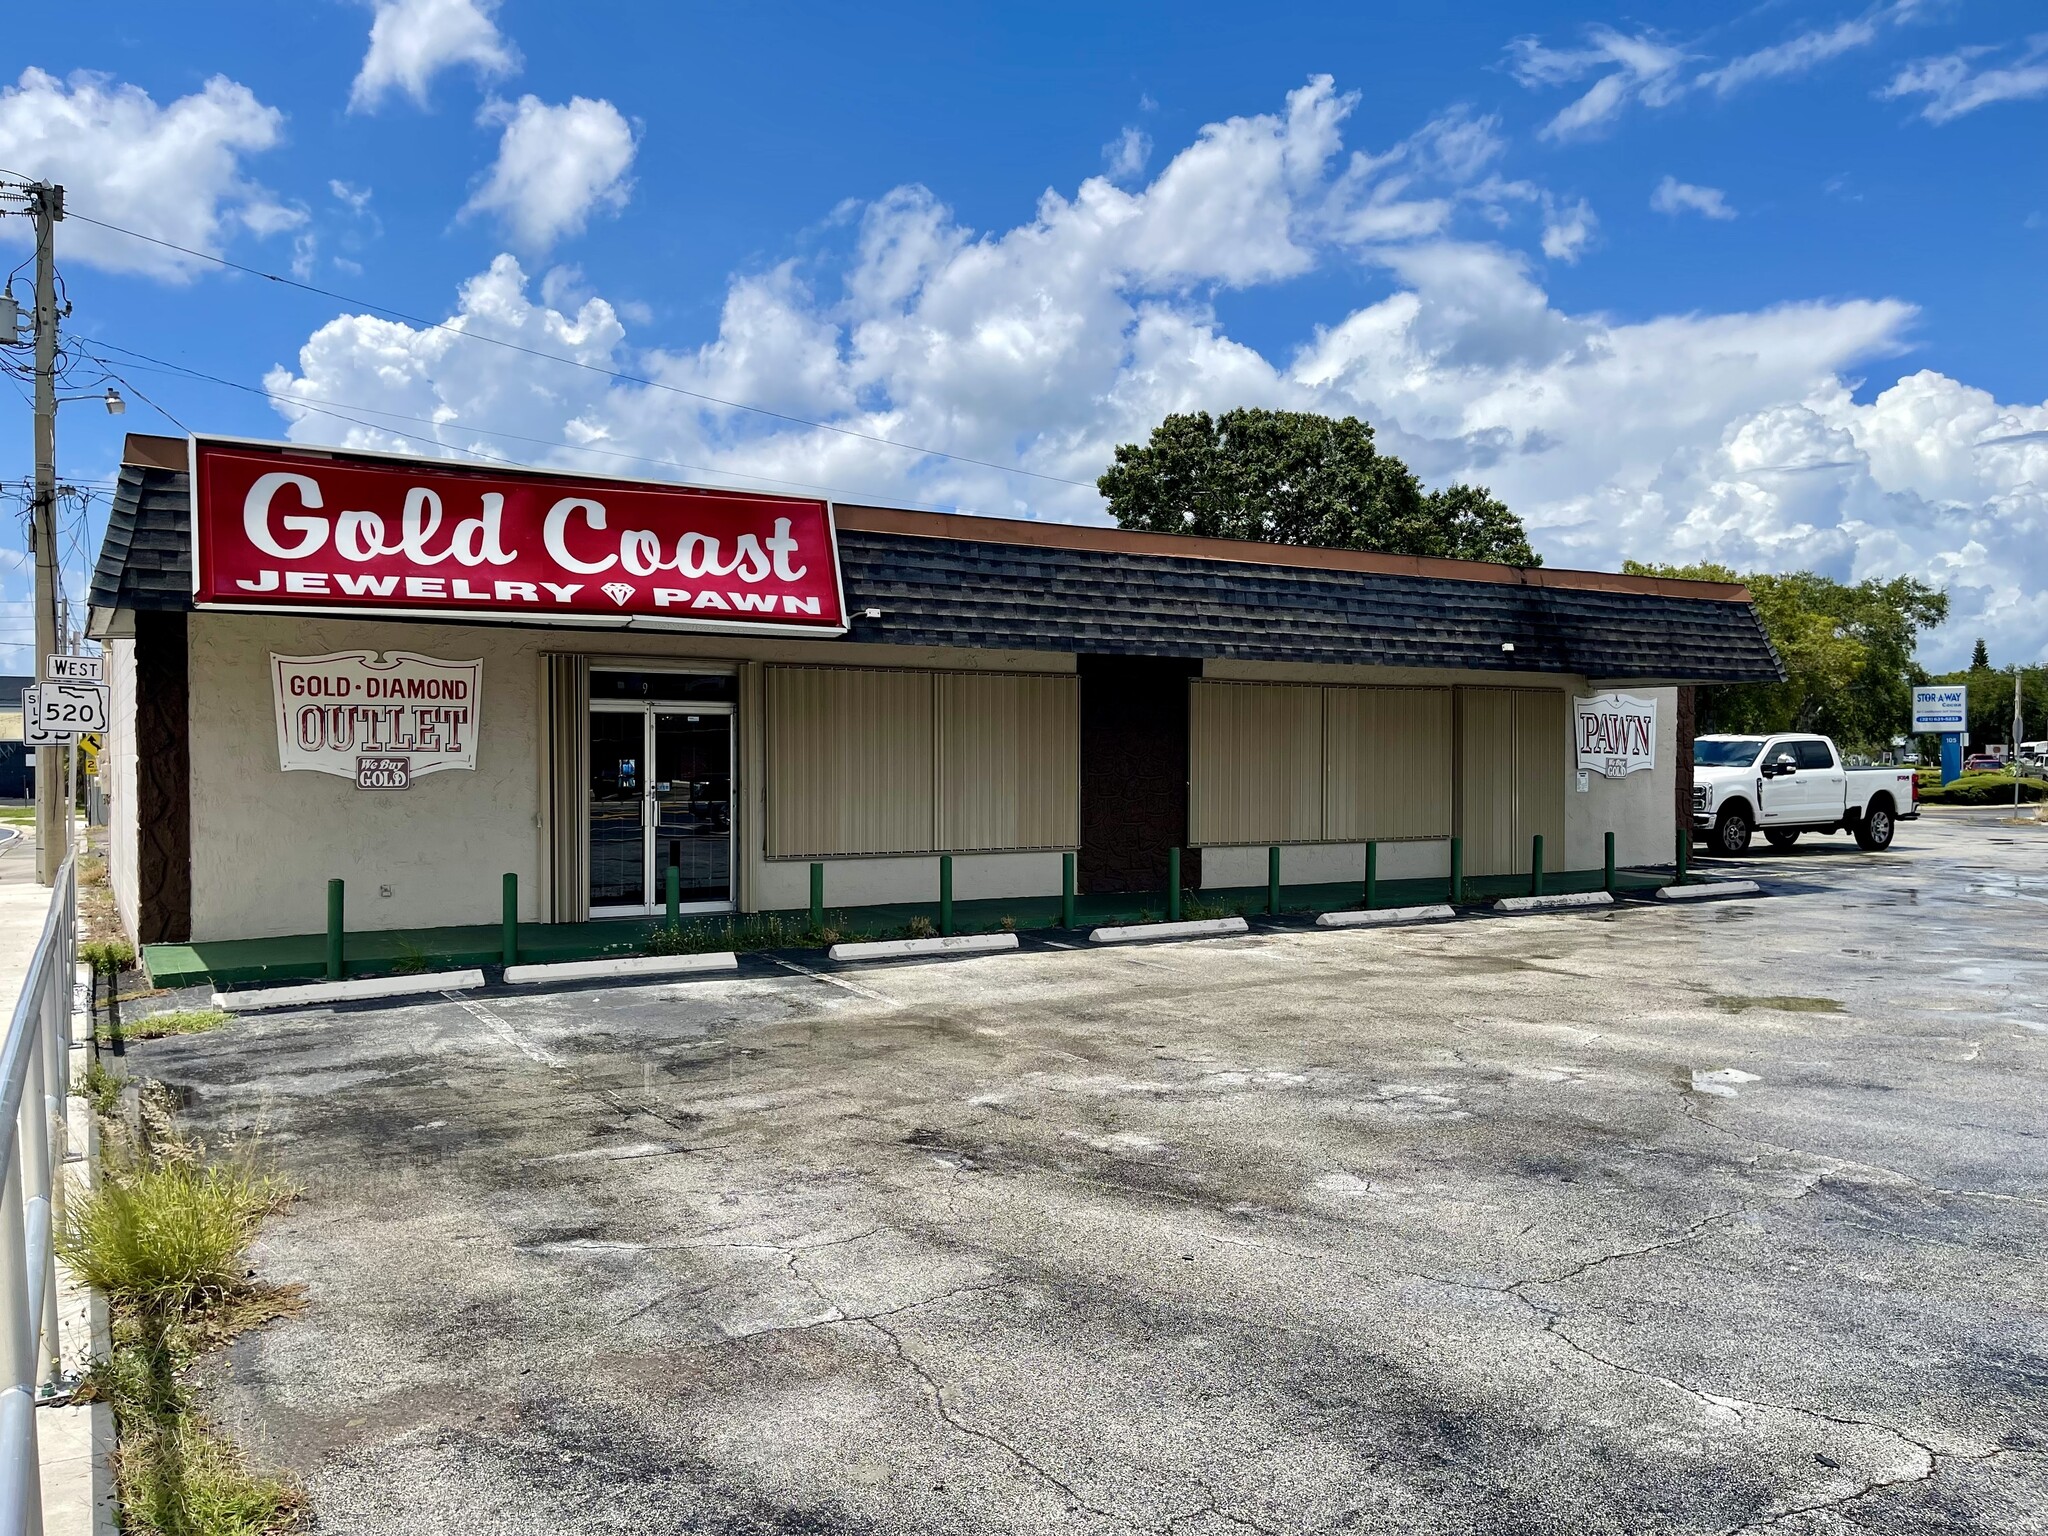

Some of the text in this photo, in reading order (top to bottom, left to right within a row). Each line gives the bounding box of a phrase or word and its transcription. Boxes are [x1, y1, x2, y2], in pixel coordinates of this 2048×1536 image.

[243, 471, 806, 583] Gold Coast
[236, 570, 821, 615] JEWELRY PAWN
[55, 660, 97, 677] WEST
[290, 675, 468, 700] GOLD DIAMOND
[1917, 692, 1961, 702] STOR A WAY
[46, 703, 94, 722] 520
[297, 704, 468, 752] OUTLET
[1580, 712, 1651, 756] PAWN
[361, 759, 405, 773] We Buy
[1607, 766, 1626, 776] GOLD
[360, 771, 406, 787] GOLD
